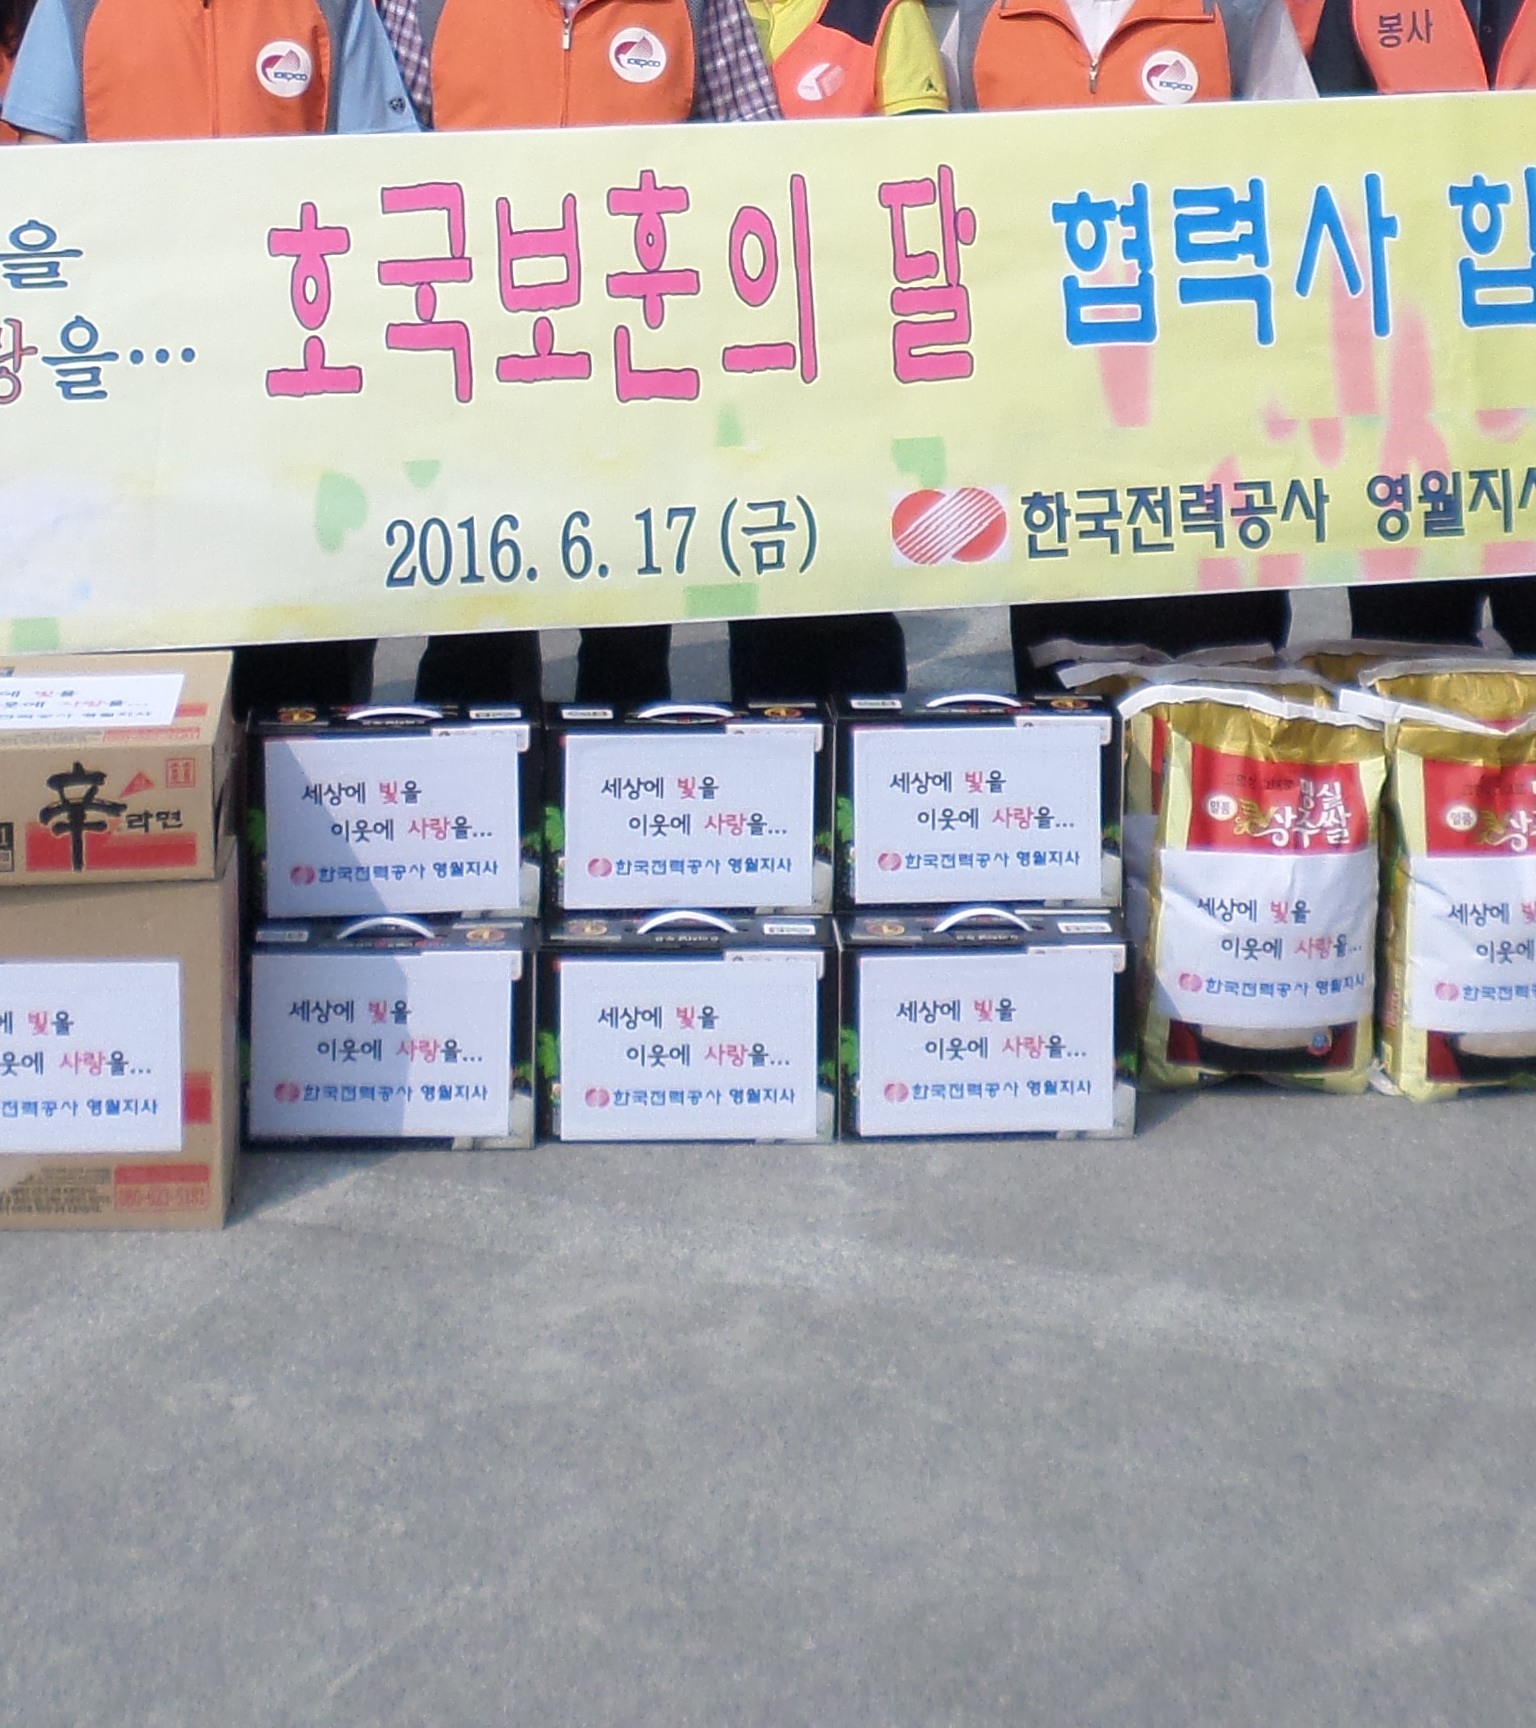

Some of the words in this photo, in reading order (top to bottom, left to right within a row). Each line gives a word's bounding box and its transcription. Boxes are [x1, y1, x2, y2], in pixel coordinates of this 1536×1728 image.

[1377, 7, 1434, 50] 봉사
[264, 168, 820, 406] 호국보훈의
[877, 162, 977, 387] 달
[1051, 168, 1400, 348] 협력사
[1019, 470, 1331, 562] 한국전력공사
[382, 515, 540, 591] 2016.
[560, 513, 614, 585] 6.
[301, 780, 367, 807] 세상에
[378, 779, 423, 805] 빛을
[601, 776, 665, 801] 세상에
[676, 775, 720, 800] 빛을
[889, 770, 953, 795] 세상에
[963, 769, 1007, 794] 빛을
[38, 760, 129, 873] 辛
[125, 809, 185, 833] 라면
[628, 813, 692, 838] 이웃에
[916, 807, 980, 832] 이웃에
[329, 818, 395, 843] 이웃에
[317, 863, 427, 884] 한국전력공사
[431, 860, 500, 880] 영월지사
[614, 857, 721, 877] 한국전력공사
[726, 856, 793, 874] 영월지사
[904, 852, 1010, 870] 한국전력공사
[1015, 850, 1081, 868] 영월지사
[1197, 896, 1258, 924] 세상에
[1270, 899, 1312, 925] 빛을
[1447, 901, 1511, 928] 세상에
[1220, 936, 1284, 962] 이웃에
[1475, 938, 1536, 965] 이웃에
[26, 1009, 75, 1037] 빛을
[288, 999, 355, 1024] 세상에
[367, 999, 413, 1026] 빛을
[597, 1005, 663, 1031] 세상에
[675, 1005, 720, 1030] 빛을
[895, 999, 962, 1024] 세상에
[973, 998, 1017, 1023] 빛을
[316, 1038, 383, 1064] 이웃에
[625, 1042, 692, 1068] 이웃에
[924, 1036, 989, 1061] 이웃에
[301, 1083, 414, 1103] 한국전력공사
[419, 1083, 489, 1103] 영월지사
[612, 1088, 722, 1107] 한국전력공사
[728, 1087, 796, 1106] 영월지사
[911, 1081, 1020, 1101] 한국전력공사
[1025, 1079, 1093, 1098] 영월지사
[85, 1097, 159, 1118] 영월지사
